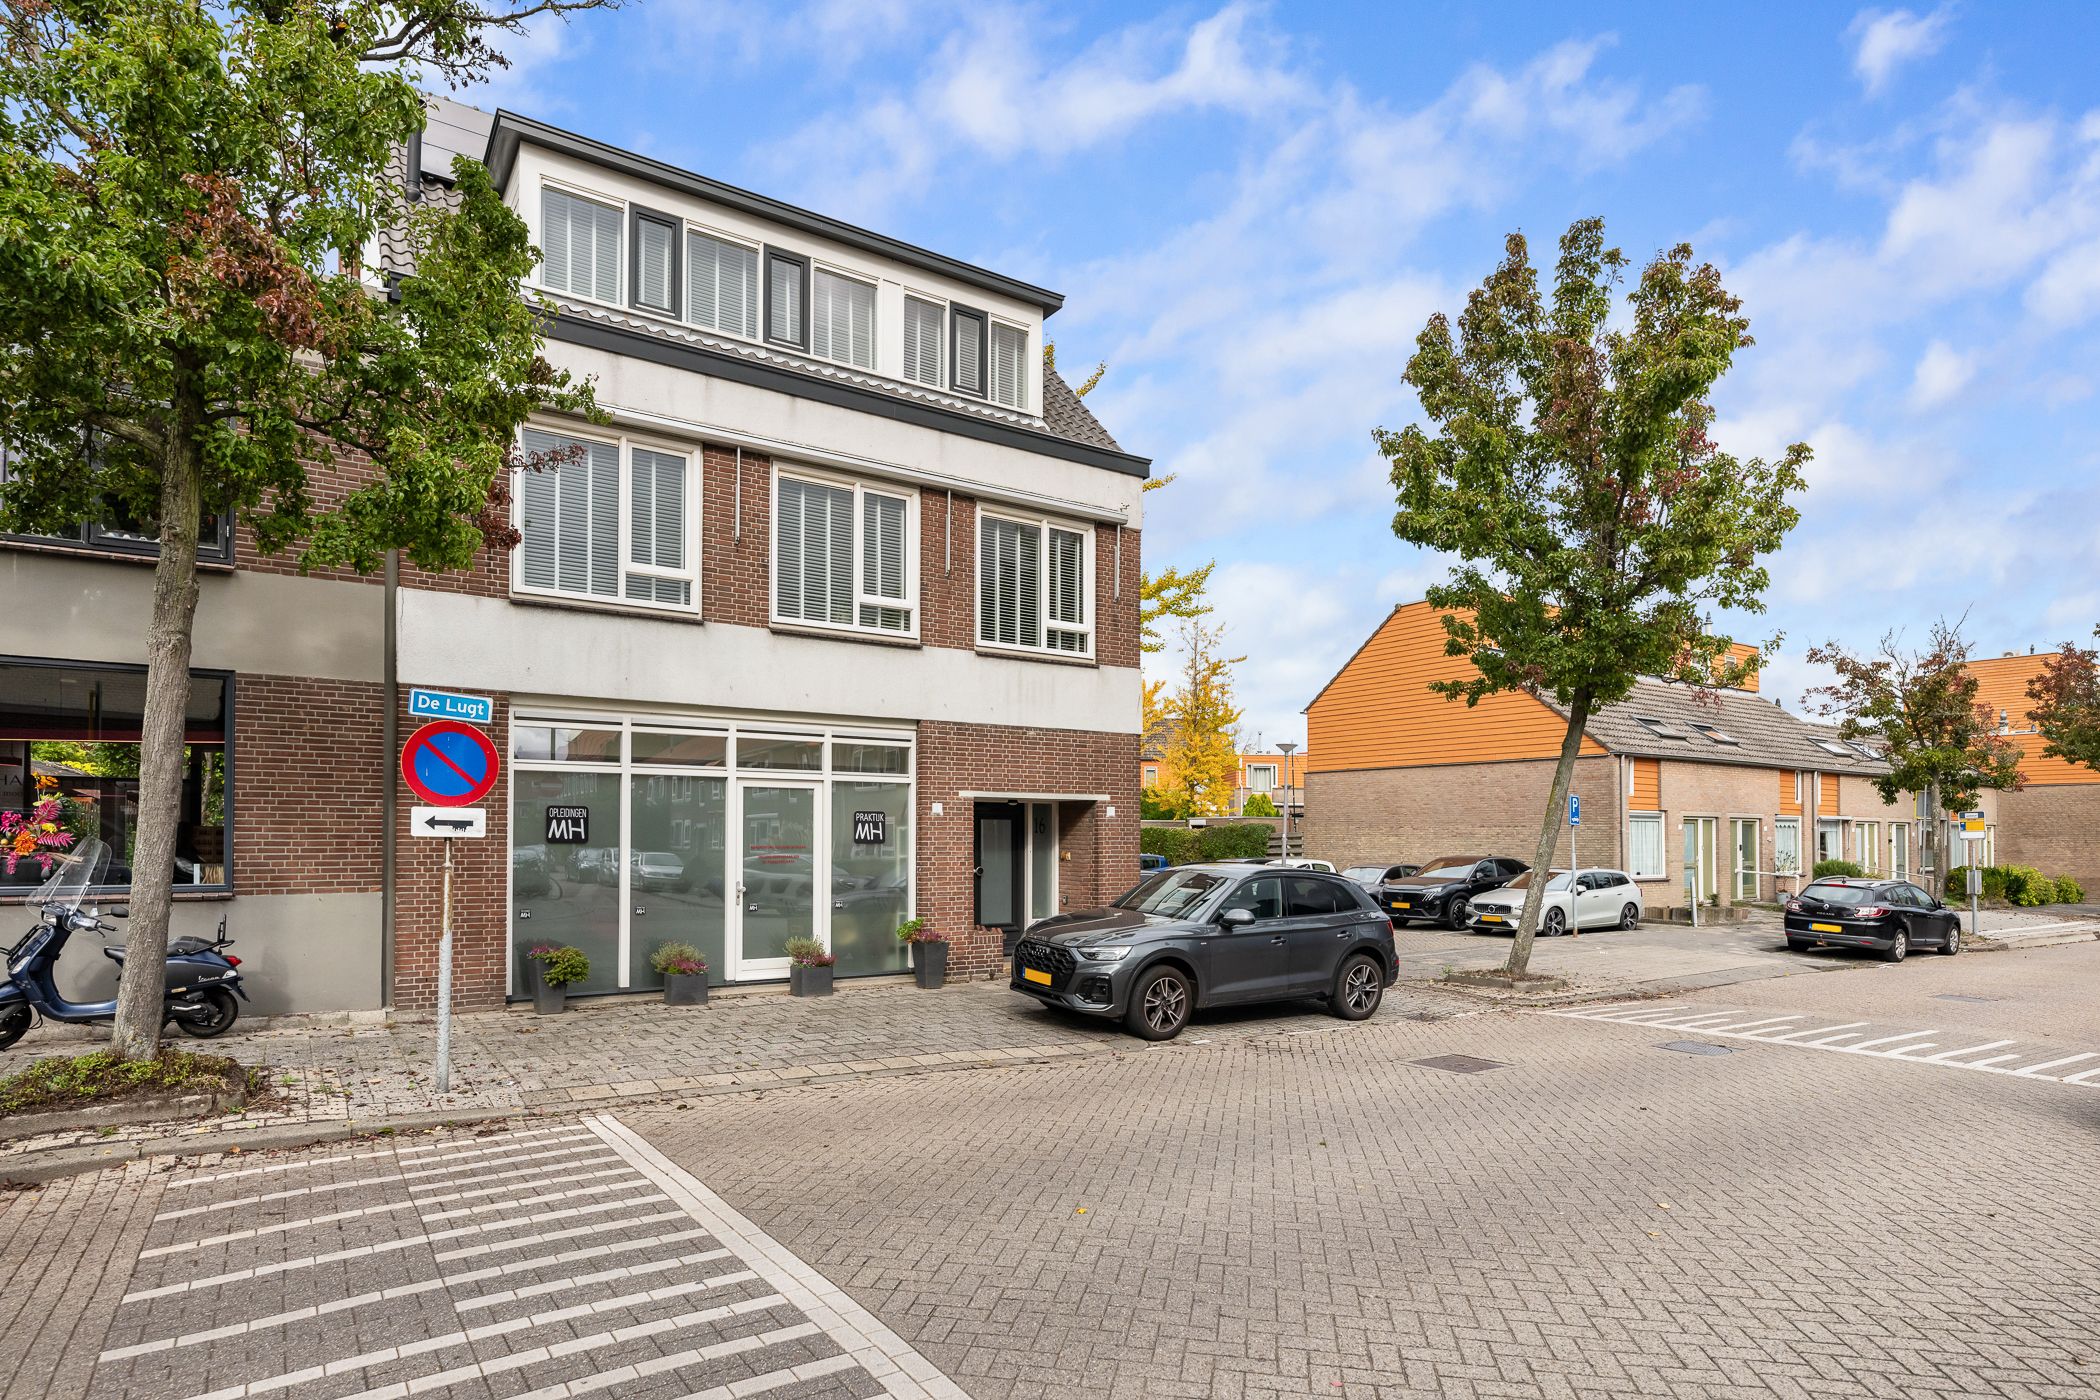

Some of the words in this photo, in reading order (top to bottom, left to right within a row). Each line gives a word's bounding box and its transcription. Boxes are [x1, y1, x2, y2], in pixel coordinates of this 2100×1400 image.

[417, 694, 440, 710] De
[445, 698, 485, 718] Lugt
[549, 807, 587, 818] OPLEIDINGEN
[1572, 797, 1579, 813] P
[855, 812, 885, 822] PRAKTIJK
[548, 818, 585, 840] MH
[855, 822, 883, 841] MH
